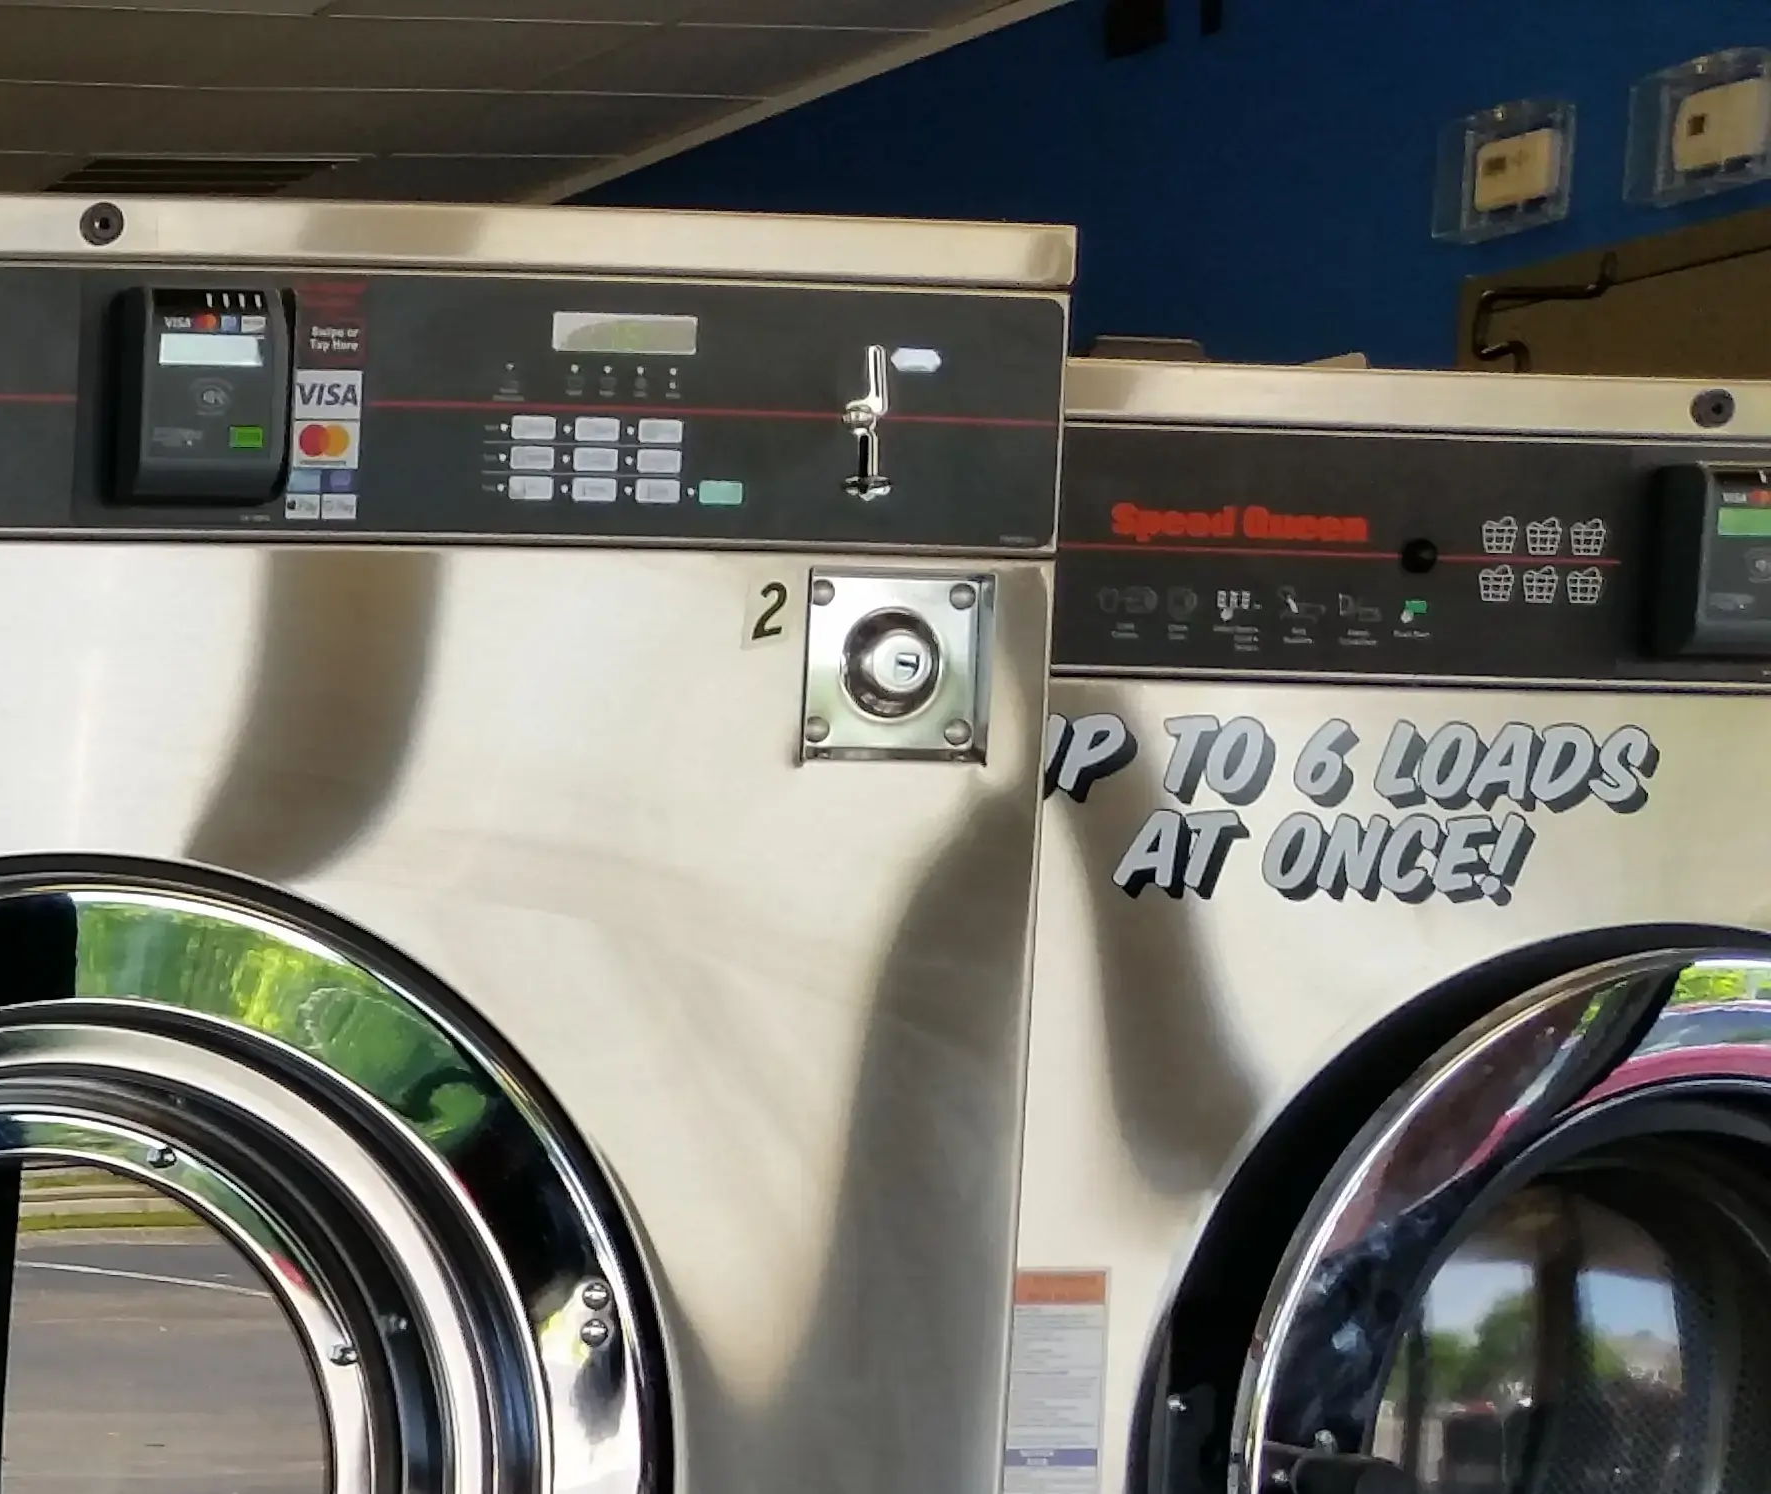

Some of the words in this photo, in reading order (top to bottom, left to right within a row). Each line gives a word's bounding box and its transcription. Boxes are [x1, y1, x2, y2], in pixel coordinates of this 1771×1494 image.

[297, 382, 360, 407] VISA
[1111, 502, 1238, 543] Speed
[1242, 505, 1370, 542] Queen
[750, 581, 789, 641] 2
[1165, 712, 1276, 807] TO
[1292, 716, 1356, 808] 6
[1372, 718, 1661, 815] LOADS
[1112, 807, 1250, 901] AT
[1260, 810, 1537, 906] ONCE!
